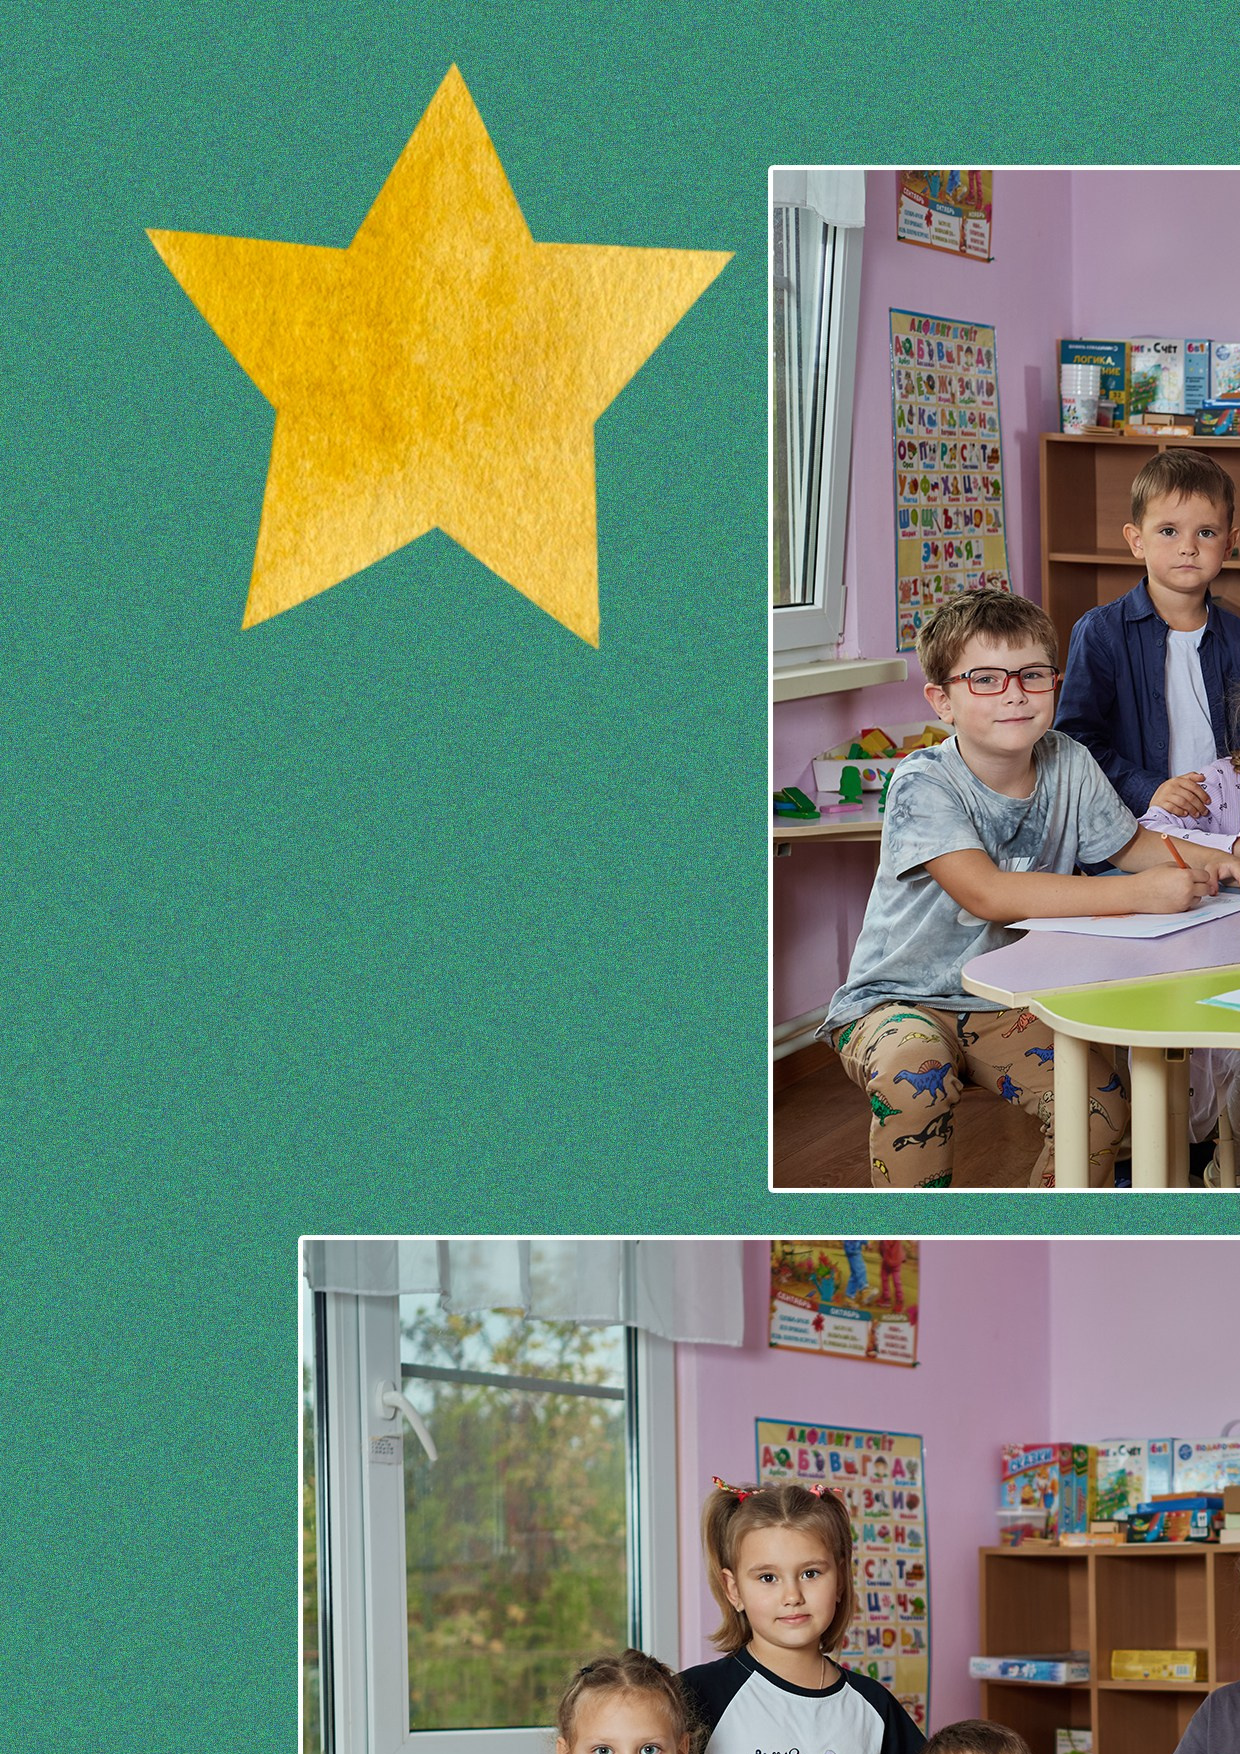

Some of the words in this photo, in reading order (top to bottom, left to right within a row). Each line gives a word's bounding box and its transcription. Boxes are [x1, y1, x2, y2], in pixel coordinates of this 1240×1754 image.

[909, 318, 952, 338] АЛФАВИТ
[895, 335, 903, 356] А
[916, 338, 925, 360] Б
[936, 342, 944, 362] В
[956, 344, 964, 366] Г
[896, 370, 903, 390] Е
[938, 375, 948, 394] Ж
[958, 377, 966, 396] З
[918, 407, 926, 427] К
[978, 412, 986, 429] Н
[898, 440, 906, 460] О
[919, 442, 928, 461] П
[940, 442, 948, 461] Р
[961, 444, 967, 462] С
[981, 444, 987, 462] Т
[898, 474, 907, 496] У
[941, 476, 951, 496] Х
[963, 474, 972, 494] Ц
[982, 476, 990, 494] Ч
[899, 508, 910, 529] Ш
[922, 508, 934, 530] Щ
[964, 508, 972, 526] Ы
[922, 542, 930, 562] Э
[944, 541, 954, 562] Ю
[965, 540, 974, 560] Я
[912, 578, 919, 596] 1
[934, 575, 942, 593] 2
[776, 1291, 812, 1309] СЕНТЯБРЬ
[830, 1308, 860, 1318] ОКТЯБРЬ
[786, 1426, 852, 1447] АЛФАВИТ
[762, 1446, 775, 1468] А
[798, 1448, 810, 1470] Б
[830, 1452, 842, 1472] В
[862, 1454, 872, 1476] Г
[1009, 1448, 1054, 1473] СКАЗКИ
[863, 1488, 874, 1509] З
[892, 1490, 904, 1510] И
[863, 1523, 876, 1542] М
[894, 1525, 906, 1544] Н
[865, 1559, 875, 1578] С
[896, 1560, 906, 1579] Т
[867, 1592, 881, 1612] Ц
[897, 1593, 908, 1612] Ч
[867, 1626, 880, 1646] Ы
